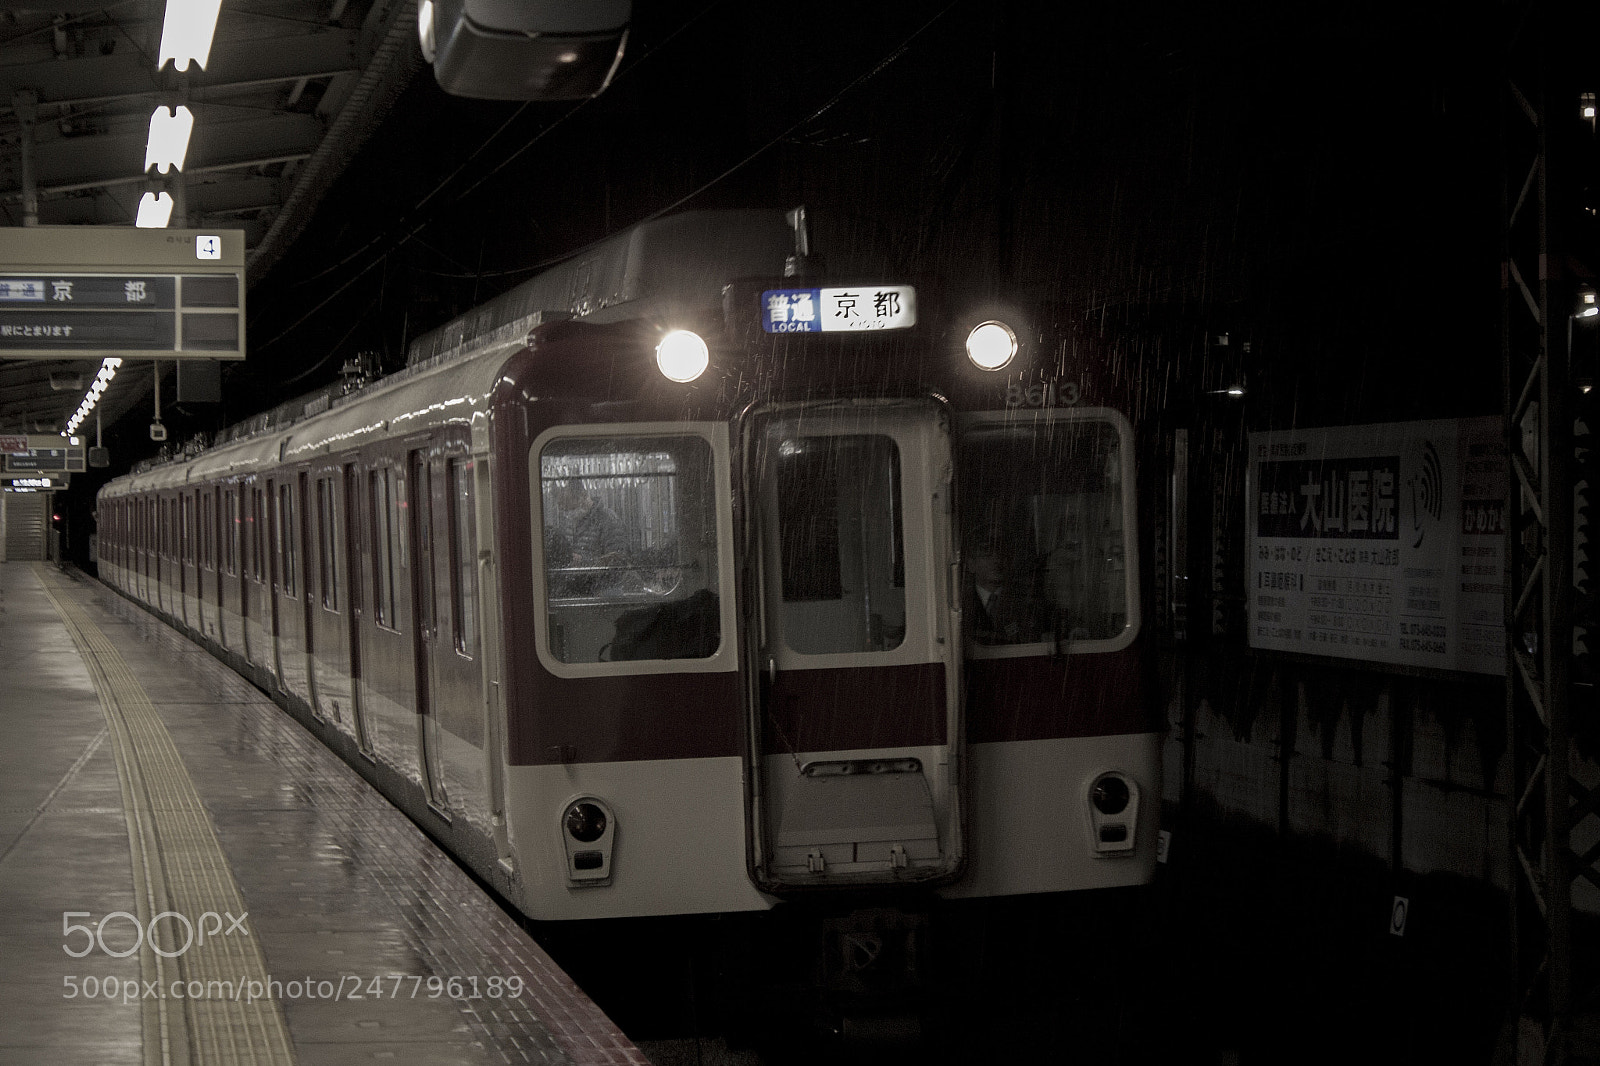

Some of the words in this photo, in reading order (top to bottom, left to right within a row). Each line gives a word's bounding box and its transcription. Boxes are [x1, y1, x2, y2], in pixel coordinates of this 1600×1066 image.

[51, 280, 147, 302] 京都
[767, 293, 815, 322] 普通
[833, 290, 900, 318] 京都
[772, 321, 812, 333] LOCAL
[1299, 467, 1395, 534] 大山医院
